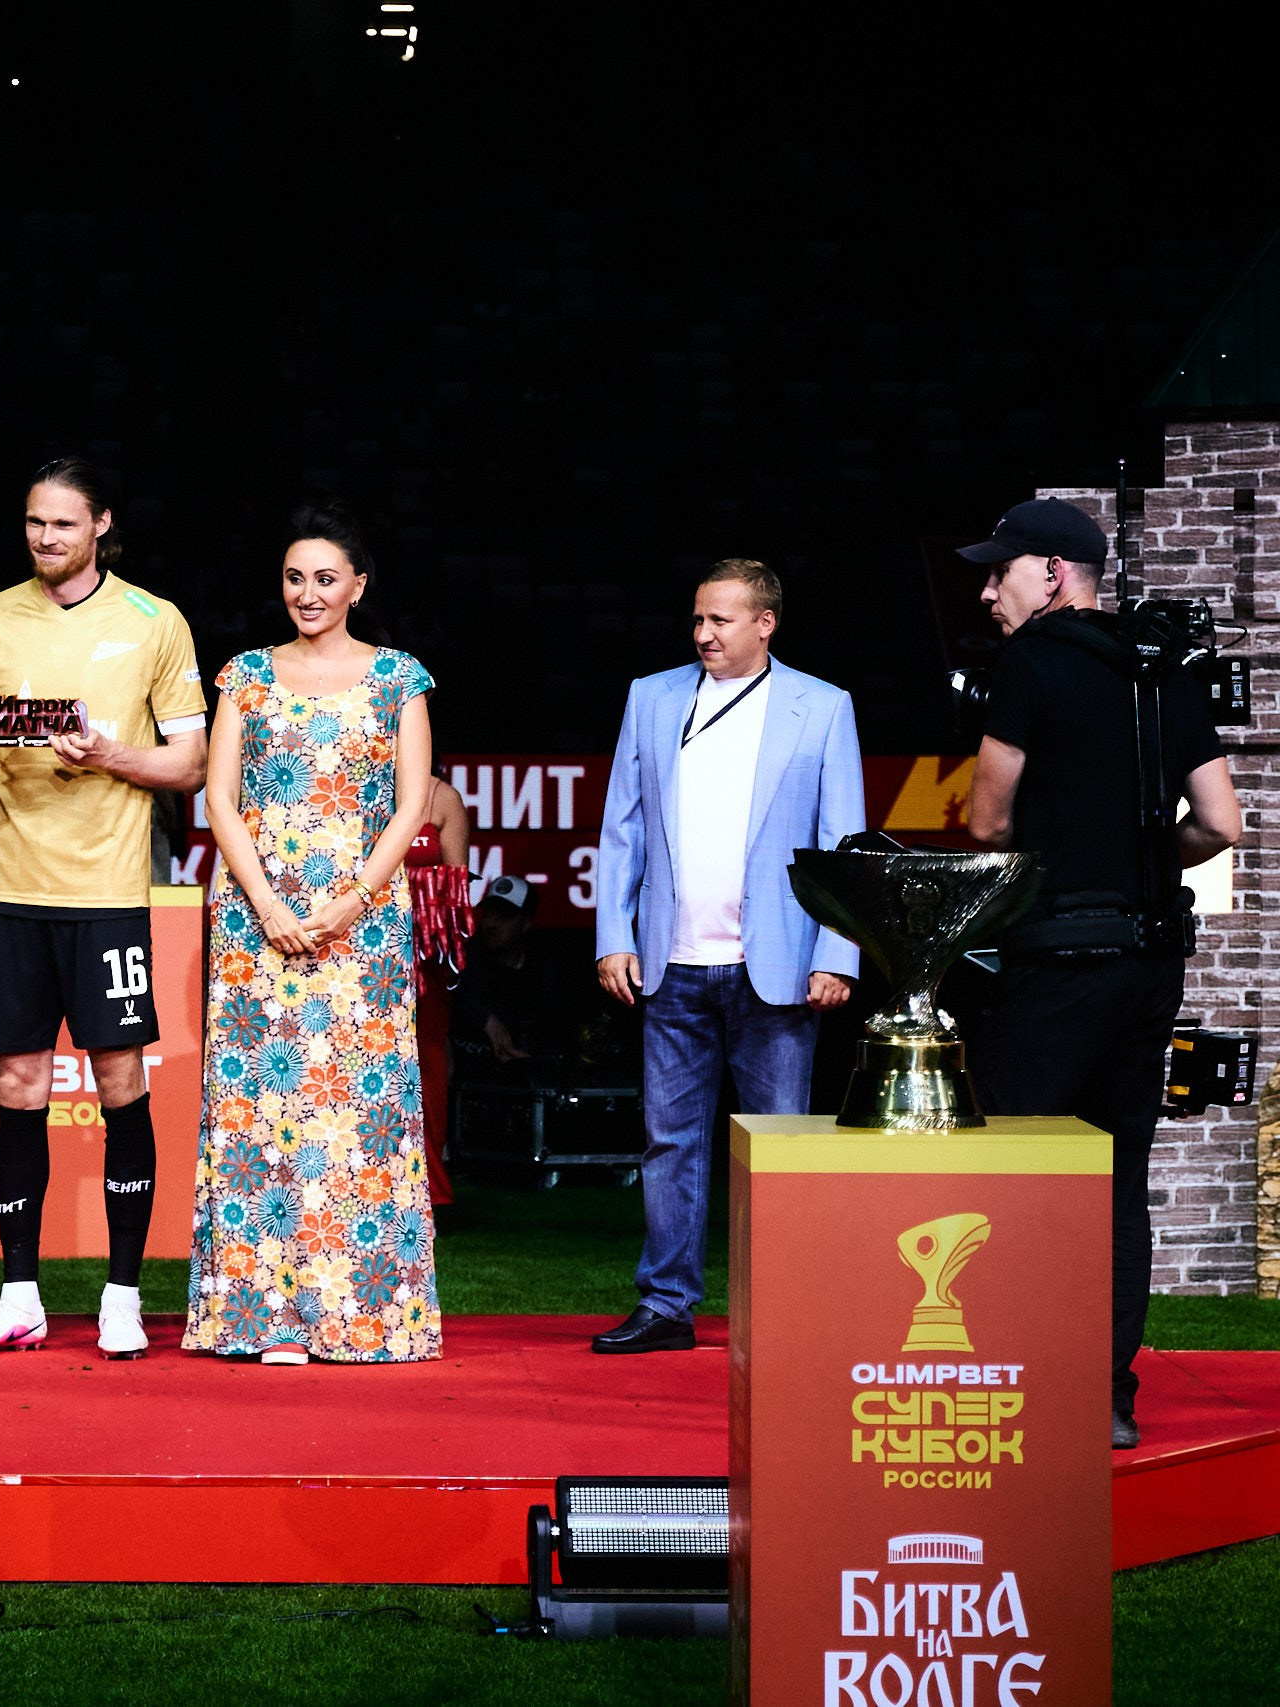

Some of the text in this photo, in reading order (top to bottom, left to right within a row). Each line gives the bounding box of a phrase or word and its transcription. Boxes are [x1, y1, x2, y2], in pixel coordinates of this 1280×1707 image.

[102, 945, 148, 999] 16
[851, 1363, 1024, 1385] OLIMPBET
[851, 1391, 1024, 1426] СУПЕР
[851, 1429, 1024, 1464] КУБОК
[884, 1470, 992, 1489] РОССИИ
